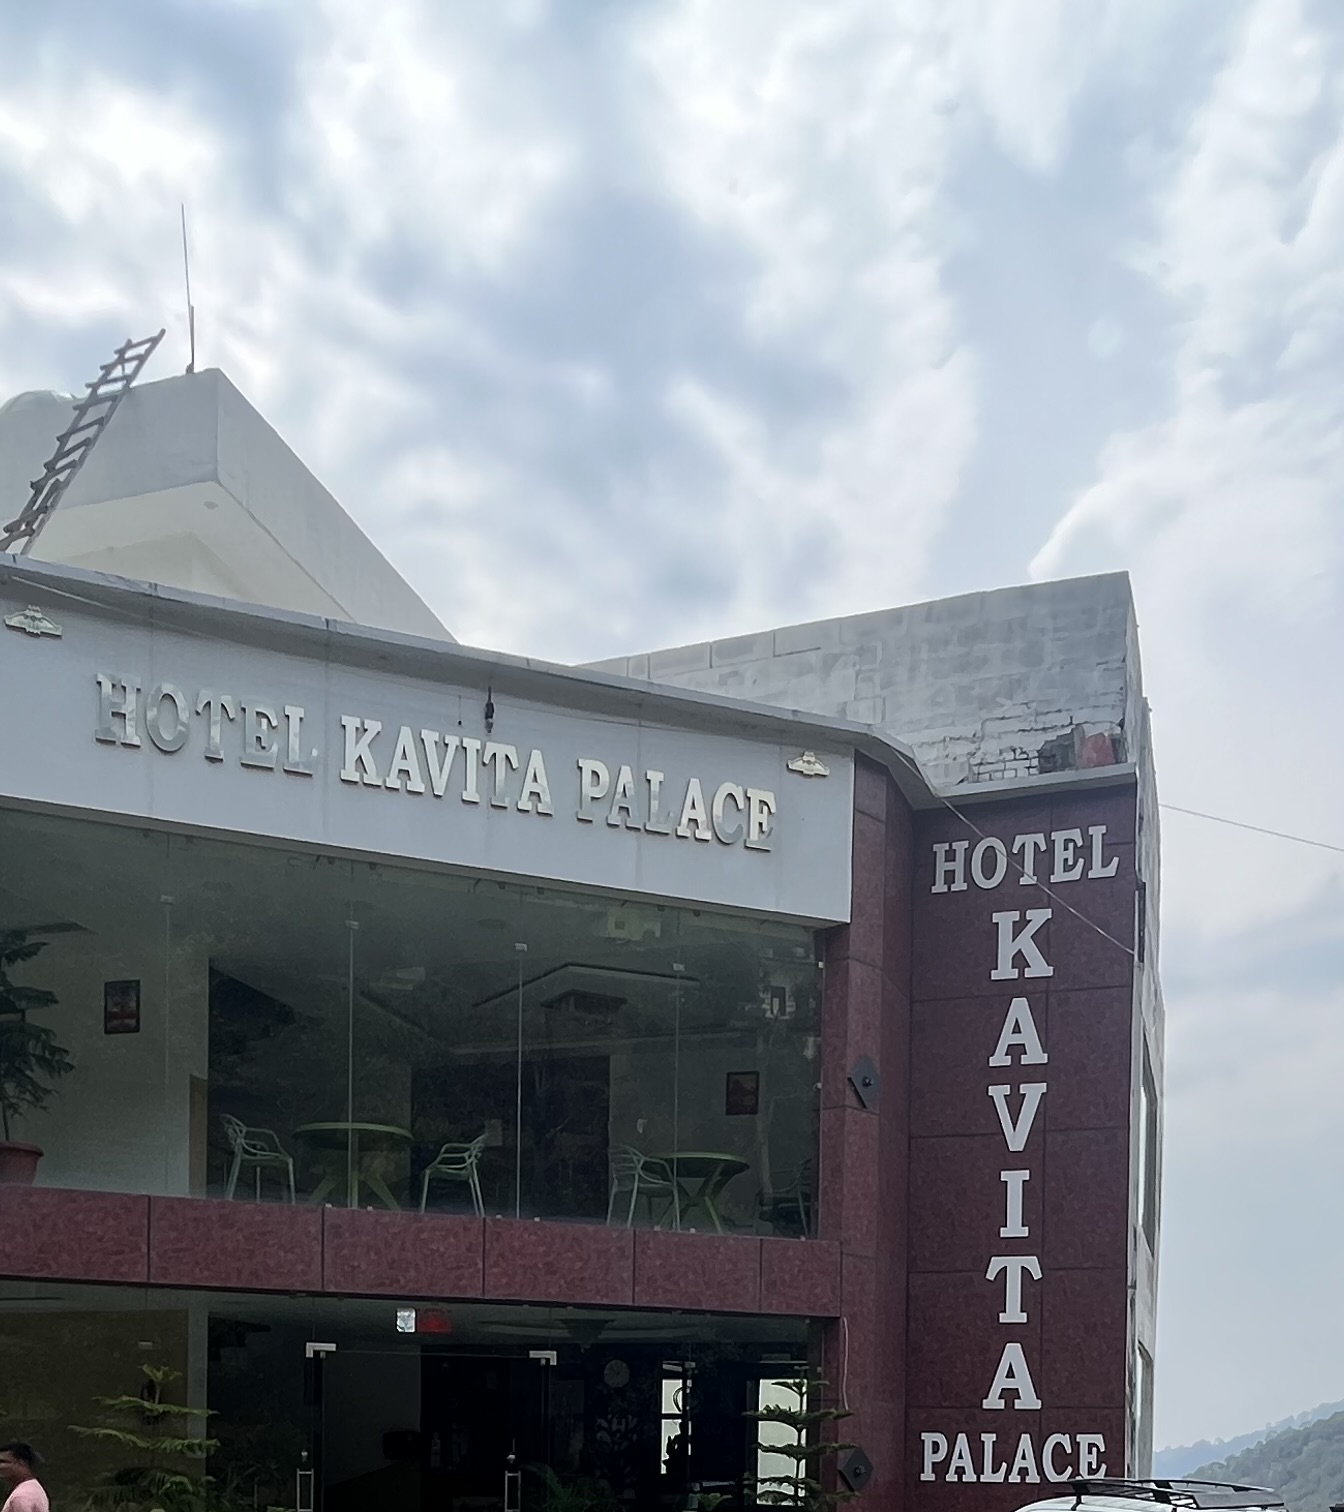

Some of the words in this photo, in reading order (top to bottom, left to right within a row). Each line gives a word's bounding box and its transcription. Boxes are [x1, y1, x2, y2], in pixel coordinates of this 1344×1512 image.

[93, 672, 319, 777] HOTEL
[340, 713, 555, 817] KAVITA
[577, 757, 777, 853] PALACE
[930, 824, 1120, 895] HOTEL
[981, 907, 1055, 1411] KAVITA
[920, 1431, 1107, 1484] PALACE
